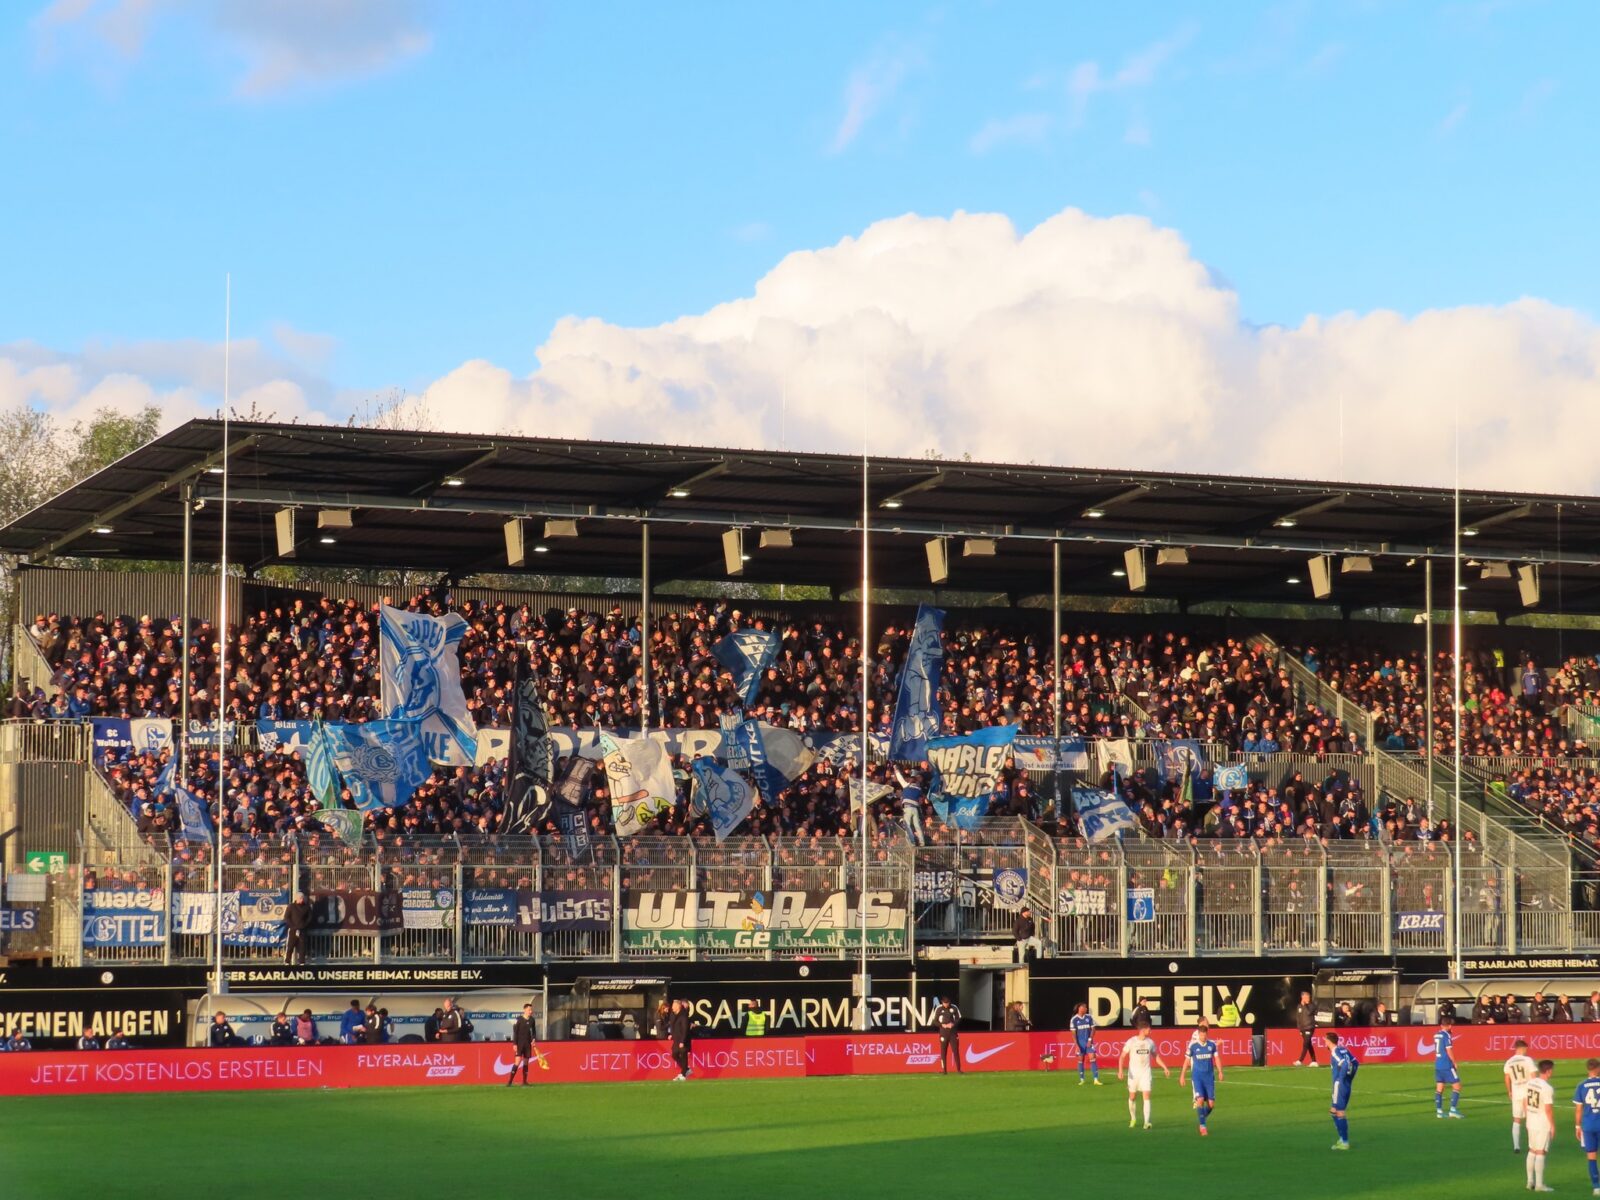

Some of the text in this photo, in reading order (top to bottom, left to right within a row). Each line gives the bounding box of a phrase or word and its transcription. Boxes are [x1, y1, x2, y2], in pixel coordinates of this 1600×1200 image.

[1398, 914, 1444, 930] KBAK
[1478, 960, 1528, 970] SAARLAND.
[1529, 959, 1564, 969] UNSERE
[1564, 958, 1600, 968] HEIMAT.
[248, 971, 316, 982] SAARLAND.
[317, 970, 364, 981] UNSERE
[366, 970, 412, 981] HEIMAT.
[413, 970, 459, 981] UNSERE
[460, 970, 483, 981] ELV.
[1088, 985, 1255, 1027] DIE ELV.
[92, 1009, 169, 1037] AUGEN
[846, 1043, 932, 1056] FLYERALARM
[1040, 1042, 1078, 1059] JETZ
[358, 1053, 455, 1067] FLYERALARM
[580, 1053, 631, 1070] JETZT
[637, 1051, 739, 1069] KOSNLOS
[31, 1059, 323, 1083] JETZT KOSTENLOS ERSTELLEN
[429, 1066, 455, 1076] sports
[1510, 1064, 1526, 1081] 14
[1527, 1088, 1540, 1109] 23
